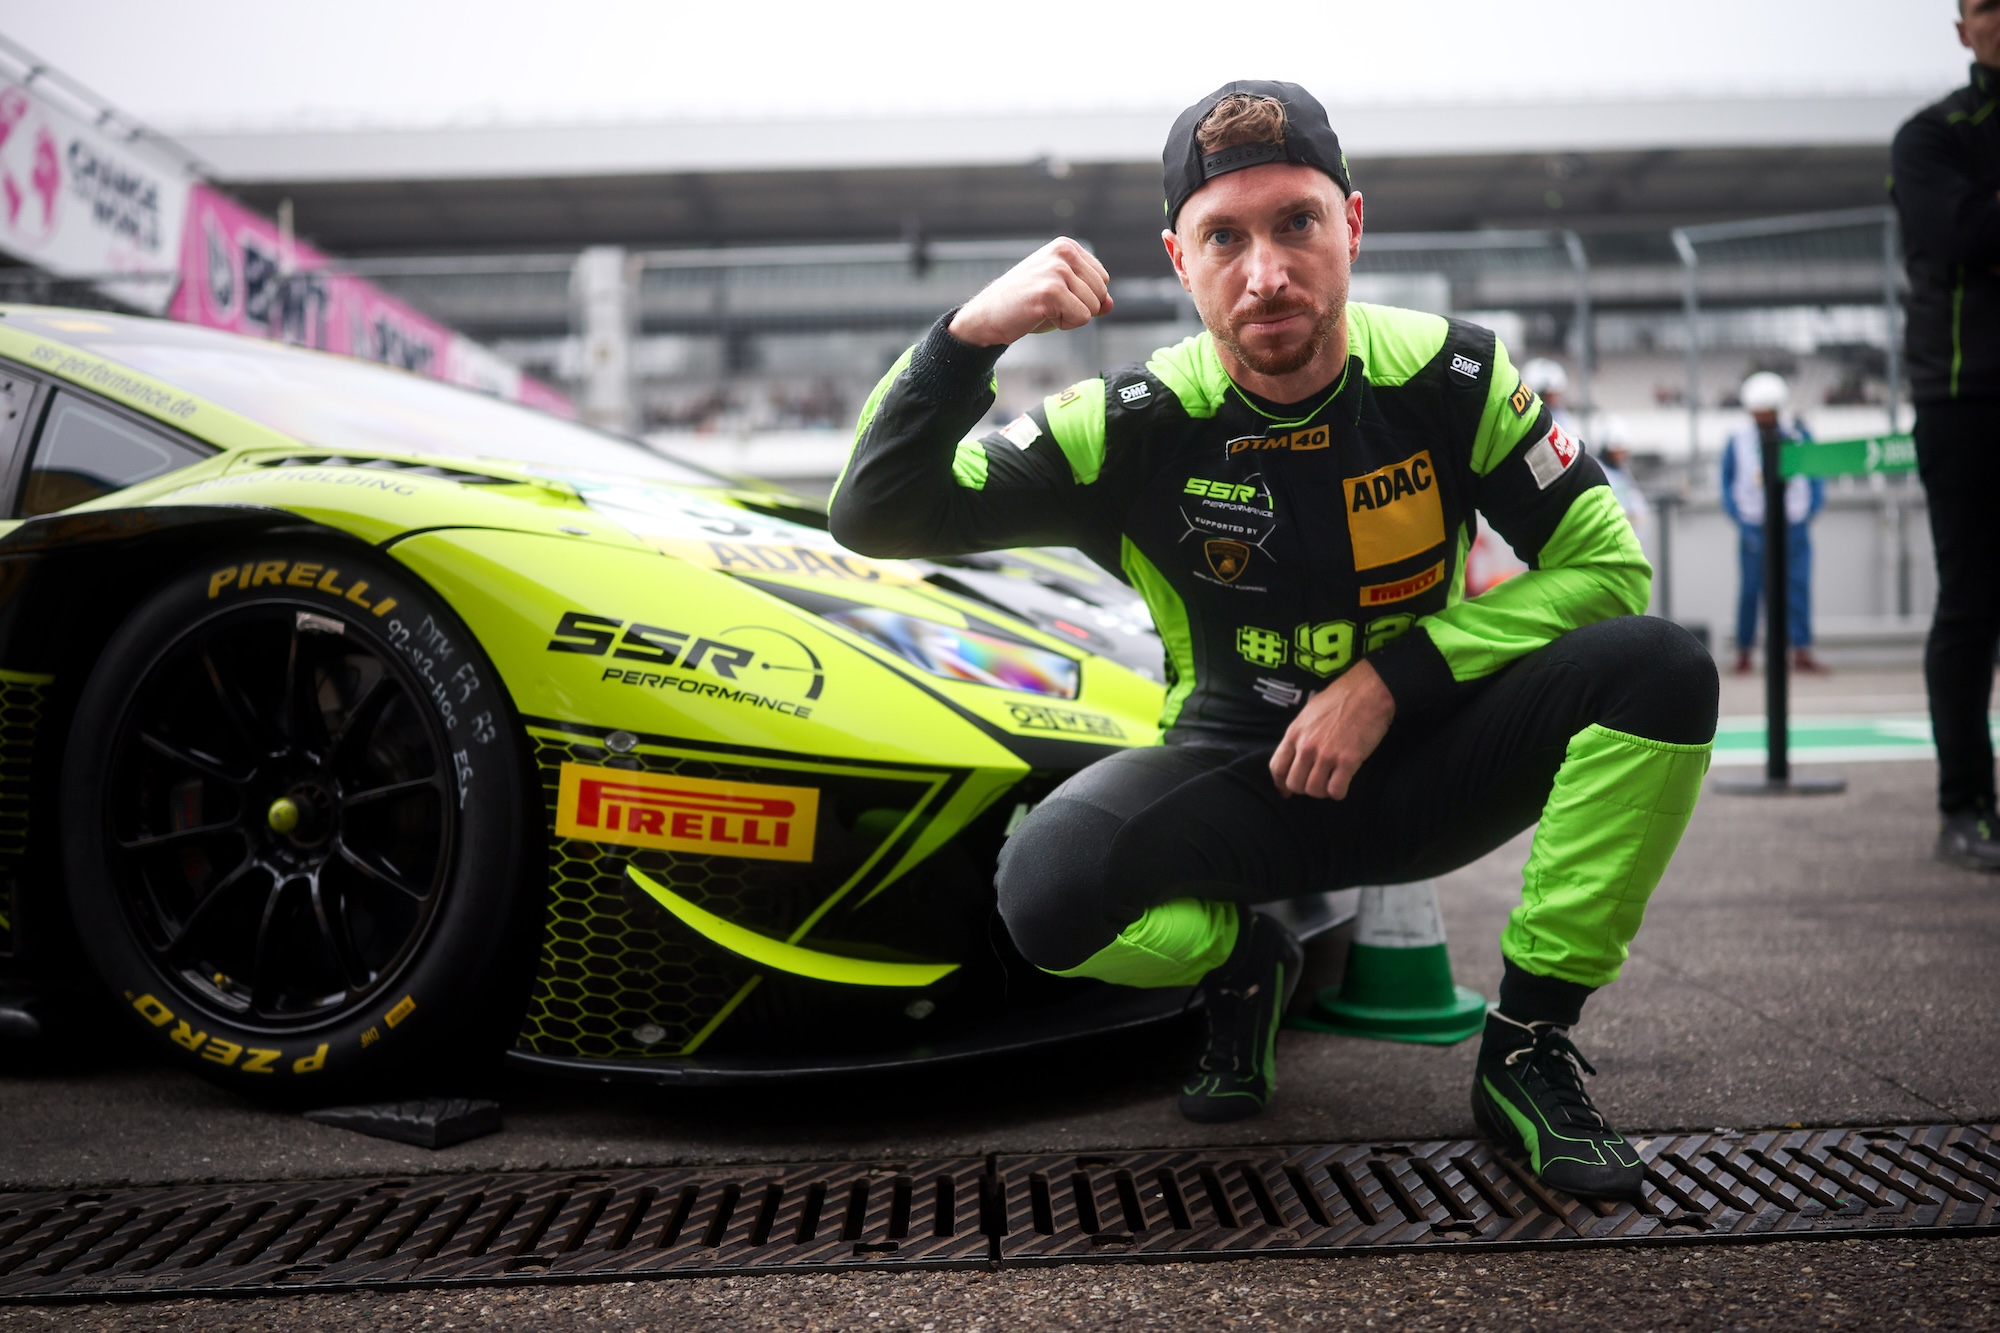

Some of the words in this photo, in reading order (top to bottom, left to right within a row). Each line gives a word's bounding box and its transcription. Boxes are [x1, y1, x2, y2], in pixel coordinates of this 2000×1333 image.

[1452, 357, 1481, 375] OMP
[1120, 383, 1149, 400] OMP
[1230, 436, 1288, 455] DTM
[1295, 430, 1326, 447] 40
[274, 471, 420, 497] HOLDING
[1183, 477, 1257, 503] SSR
[1352, 458, 1432, 513] ADAC
[1194, 516, 1245, 533] SUPPORTED
[1246, 527, 1259, 536] BY
[1201, 499, 1274, 519] PERFORMANCE
[706, 540, 881, 581] ADAC
[207, 560, 398, 618] PIRELLI
[417, 613, 454, 662] DTM
[546, 610, 756, 681] SSR
[601, 667, 813, 720] PERFORMANCE
[575, 777, 797, 848] PIRELLI
[132, 993, 283, 1074] ZERO
[292, 1042, 330, 1074] P
